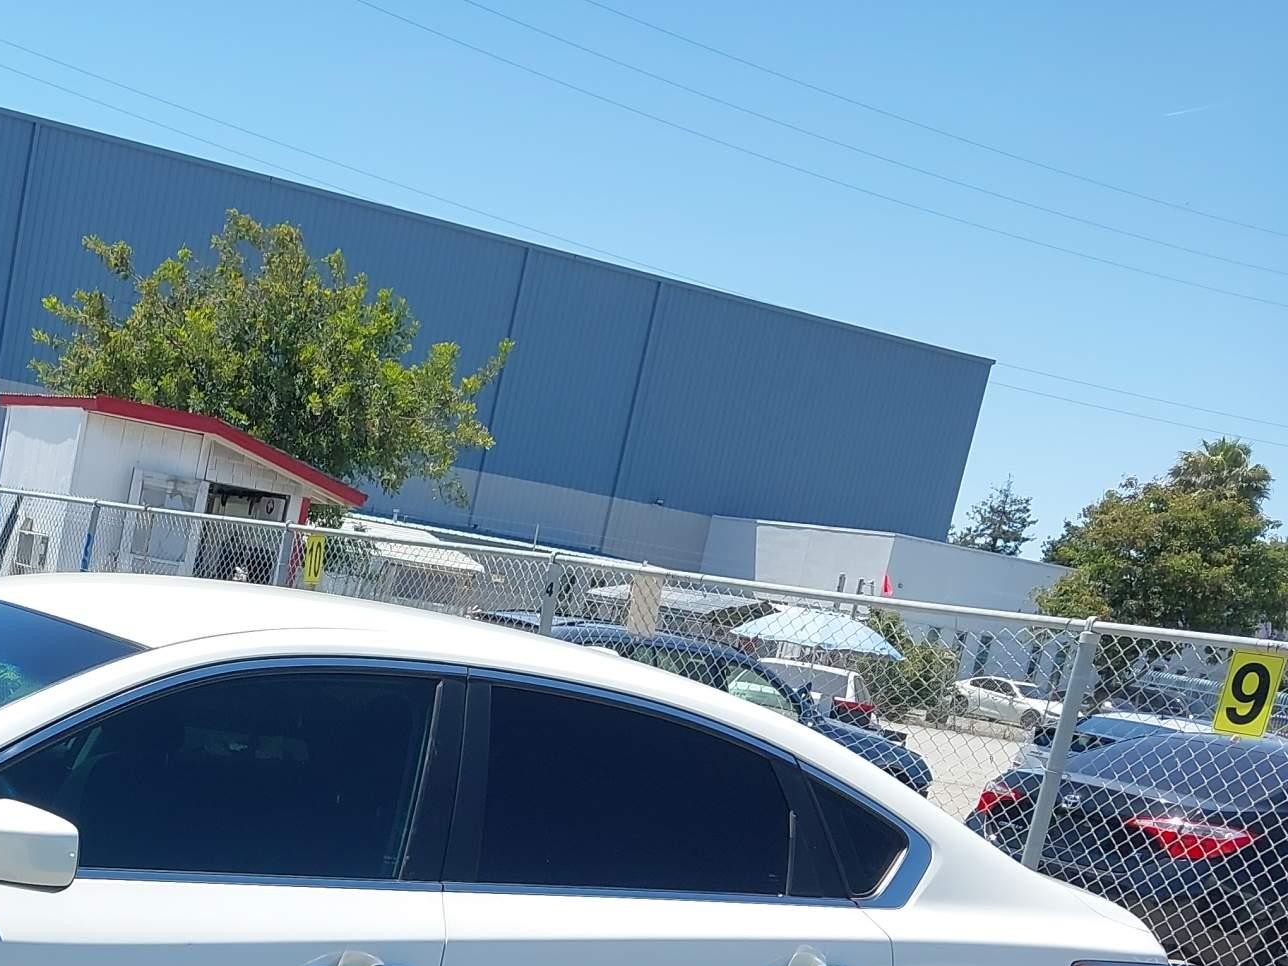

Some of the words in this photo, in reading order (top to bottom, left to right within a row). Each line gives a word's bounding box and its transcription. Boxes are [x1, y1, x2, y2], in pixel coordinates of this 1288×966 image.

[308, 541, 322, 578] 10
[545, 581, 554, 598] 4
[1225, 662, 1271, 725] 9
